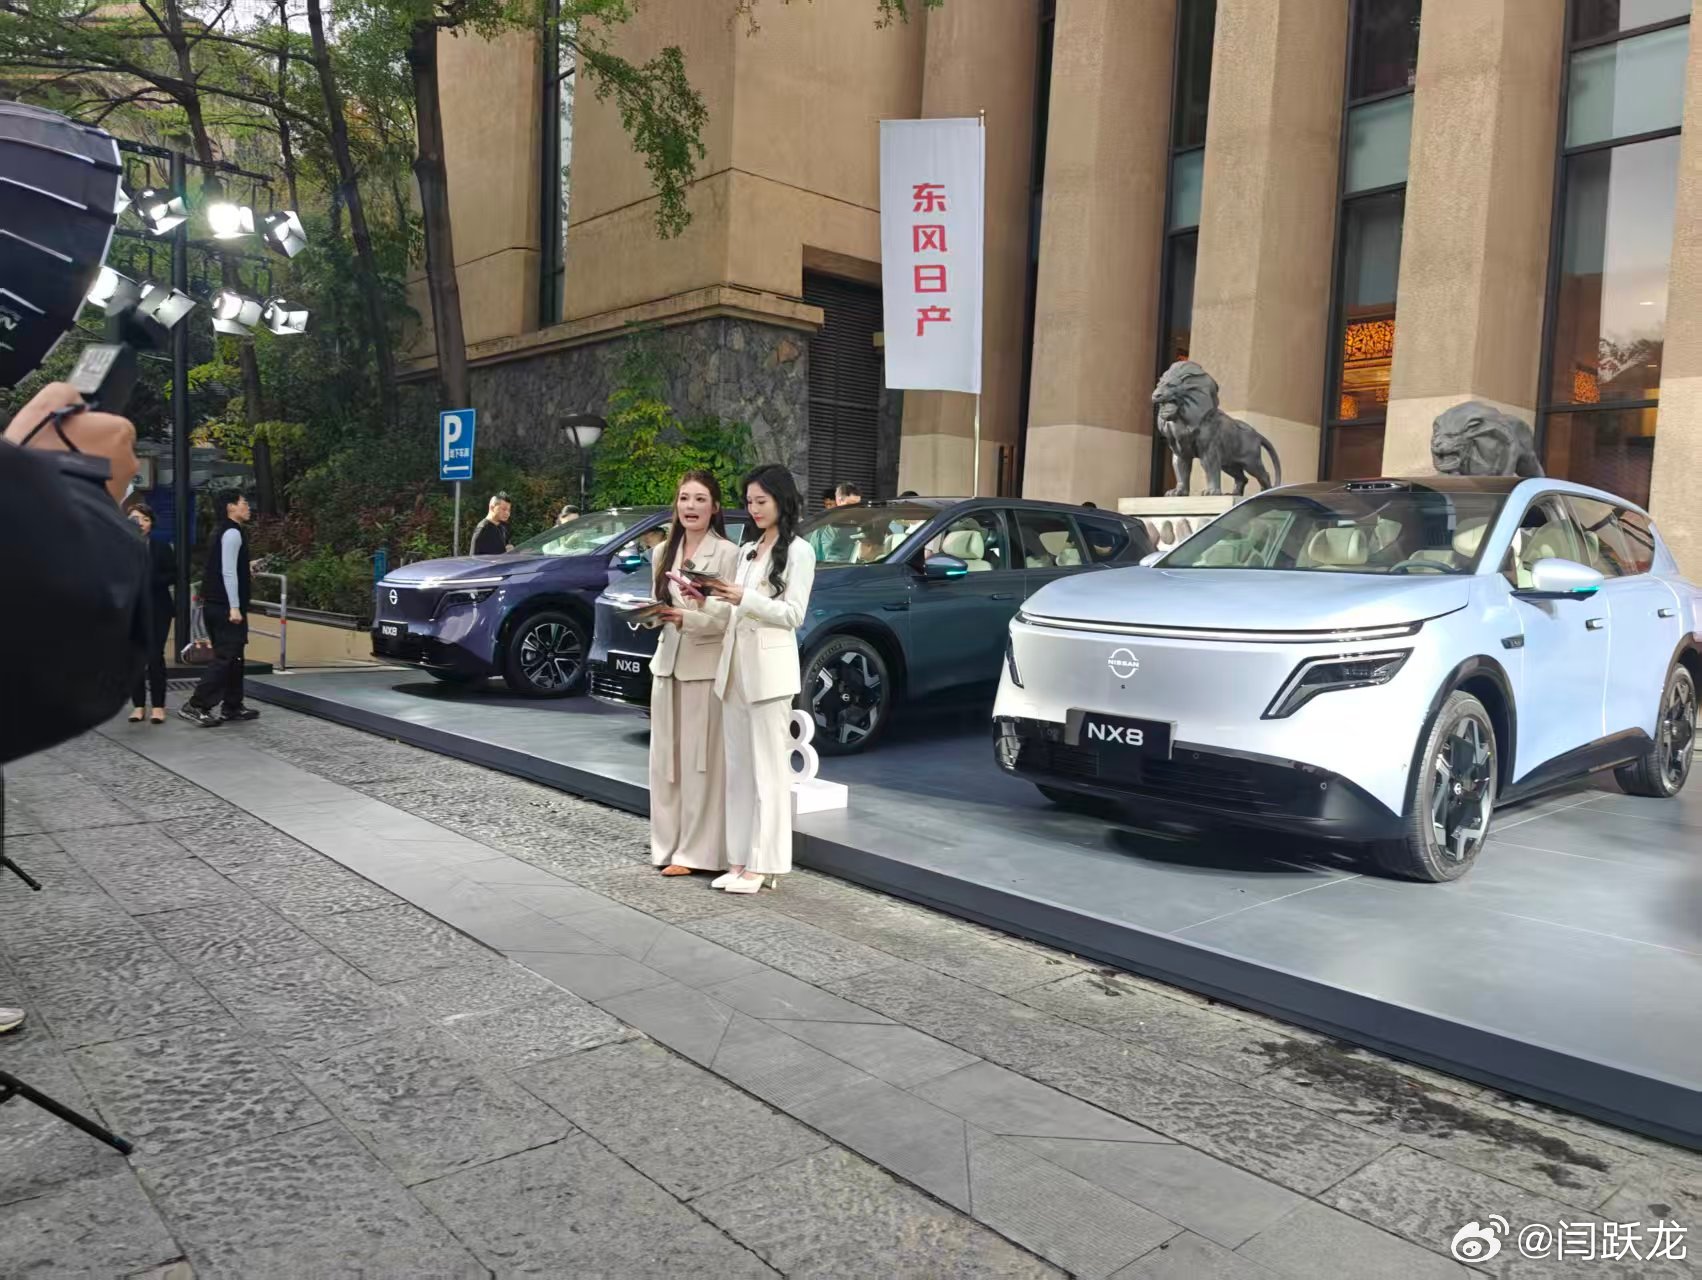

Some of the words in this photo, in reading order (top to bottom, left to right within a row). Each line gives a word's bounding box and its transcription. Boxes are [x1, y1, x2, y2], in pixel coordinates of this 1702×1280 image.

[912, 183, 951, 336] 东风日产
[444, 415, 462, 461] P
[382, 625, 398, 636] NX8
[616, 659, 640, 673] NX8
[1108, 659, 1139, 667] NISSAN
[1088, 722, 1143, 746] NX8
